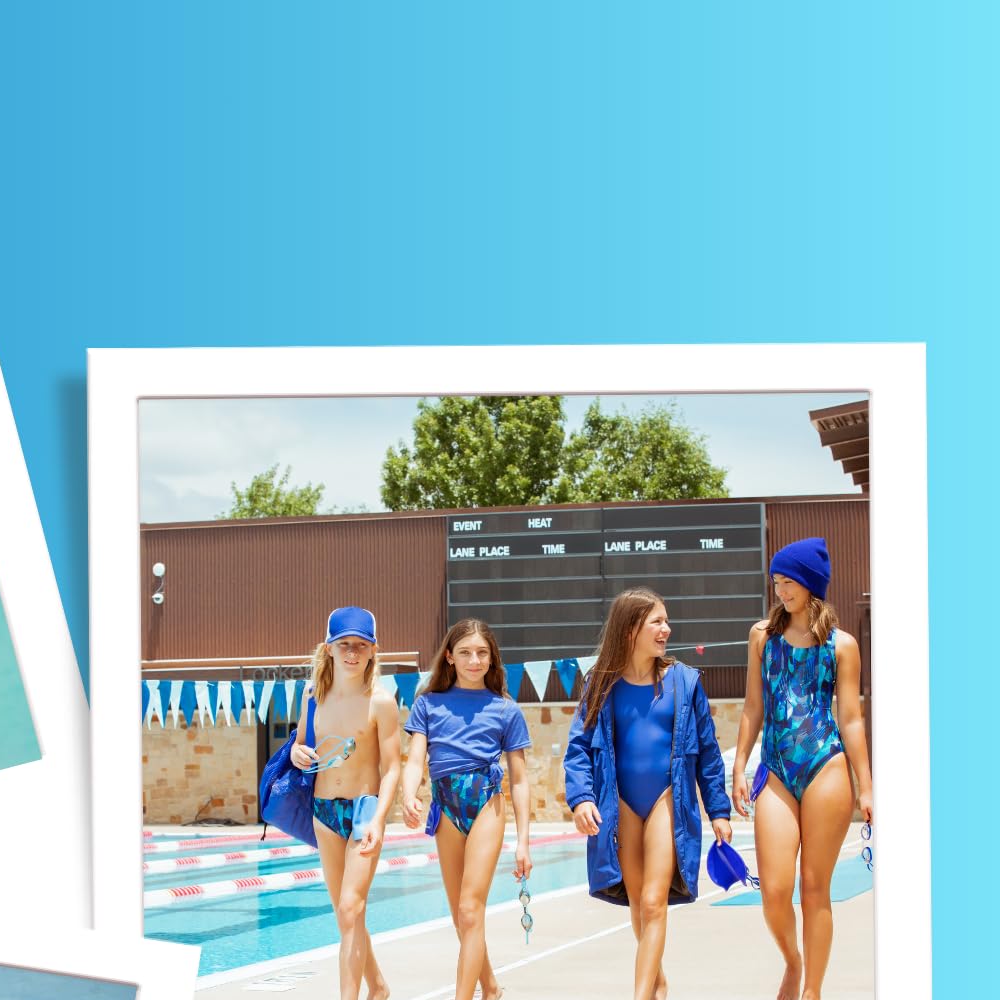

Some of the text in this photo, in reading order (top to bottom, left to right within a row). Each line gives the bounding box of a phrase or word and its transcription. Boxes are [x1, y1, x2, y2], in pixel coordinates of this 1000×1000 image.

[453, 517, 553, 532] EVENT HEAT
[449, 543, 566, 558] LANE PLACE TIME
[604, 538, 724, 553] LANE PLACE TIME
